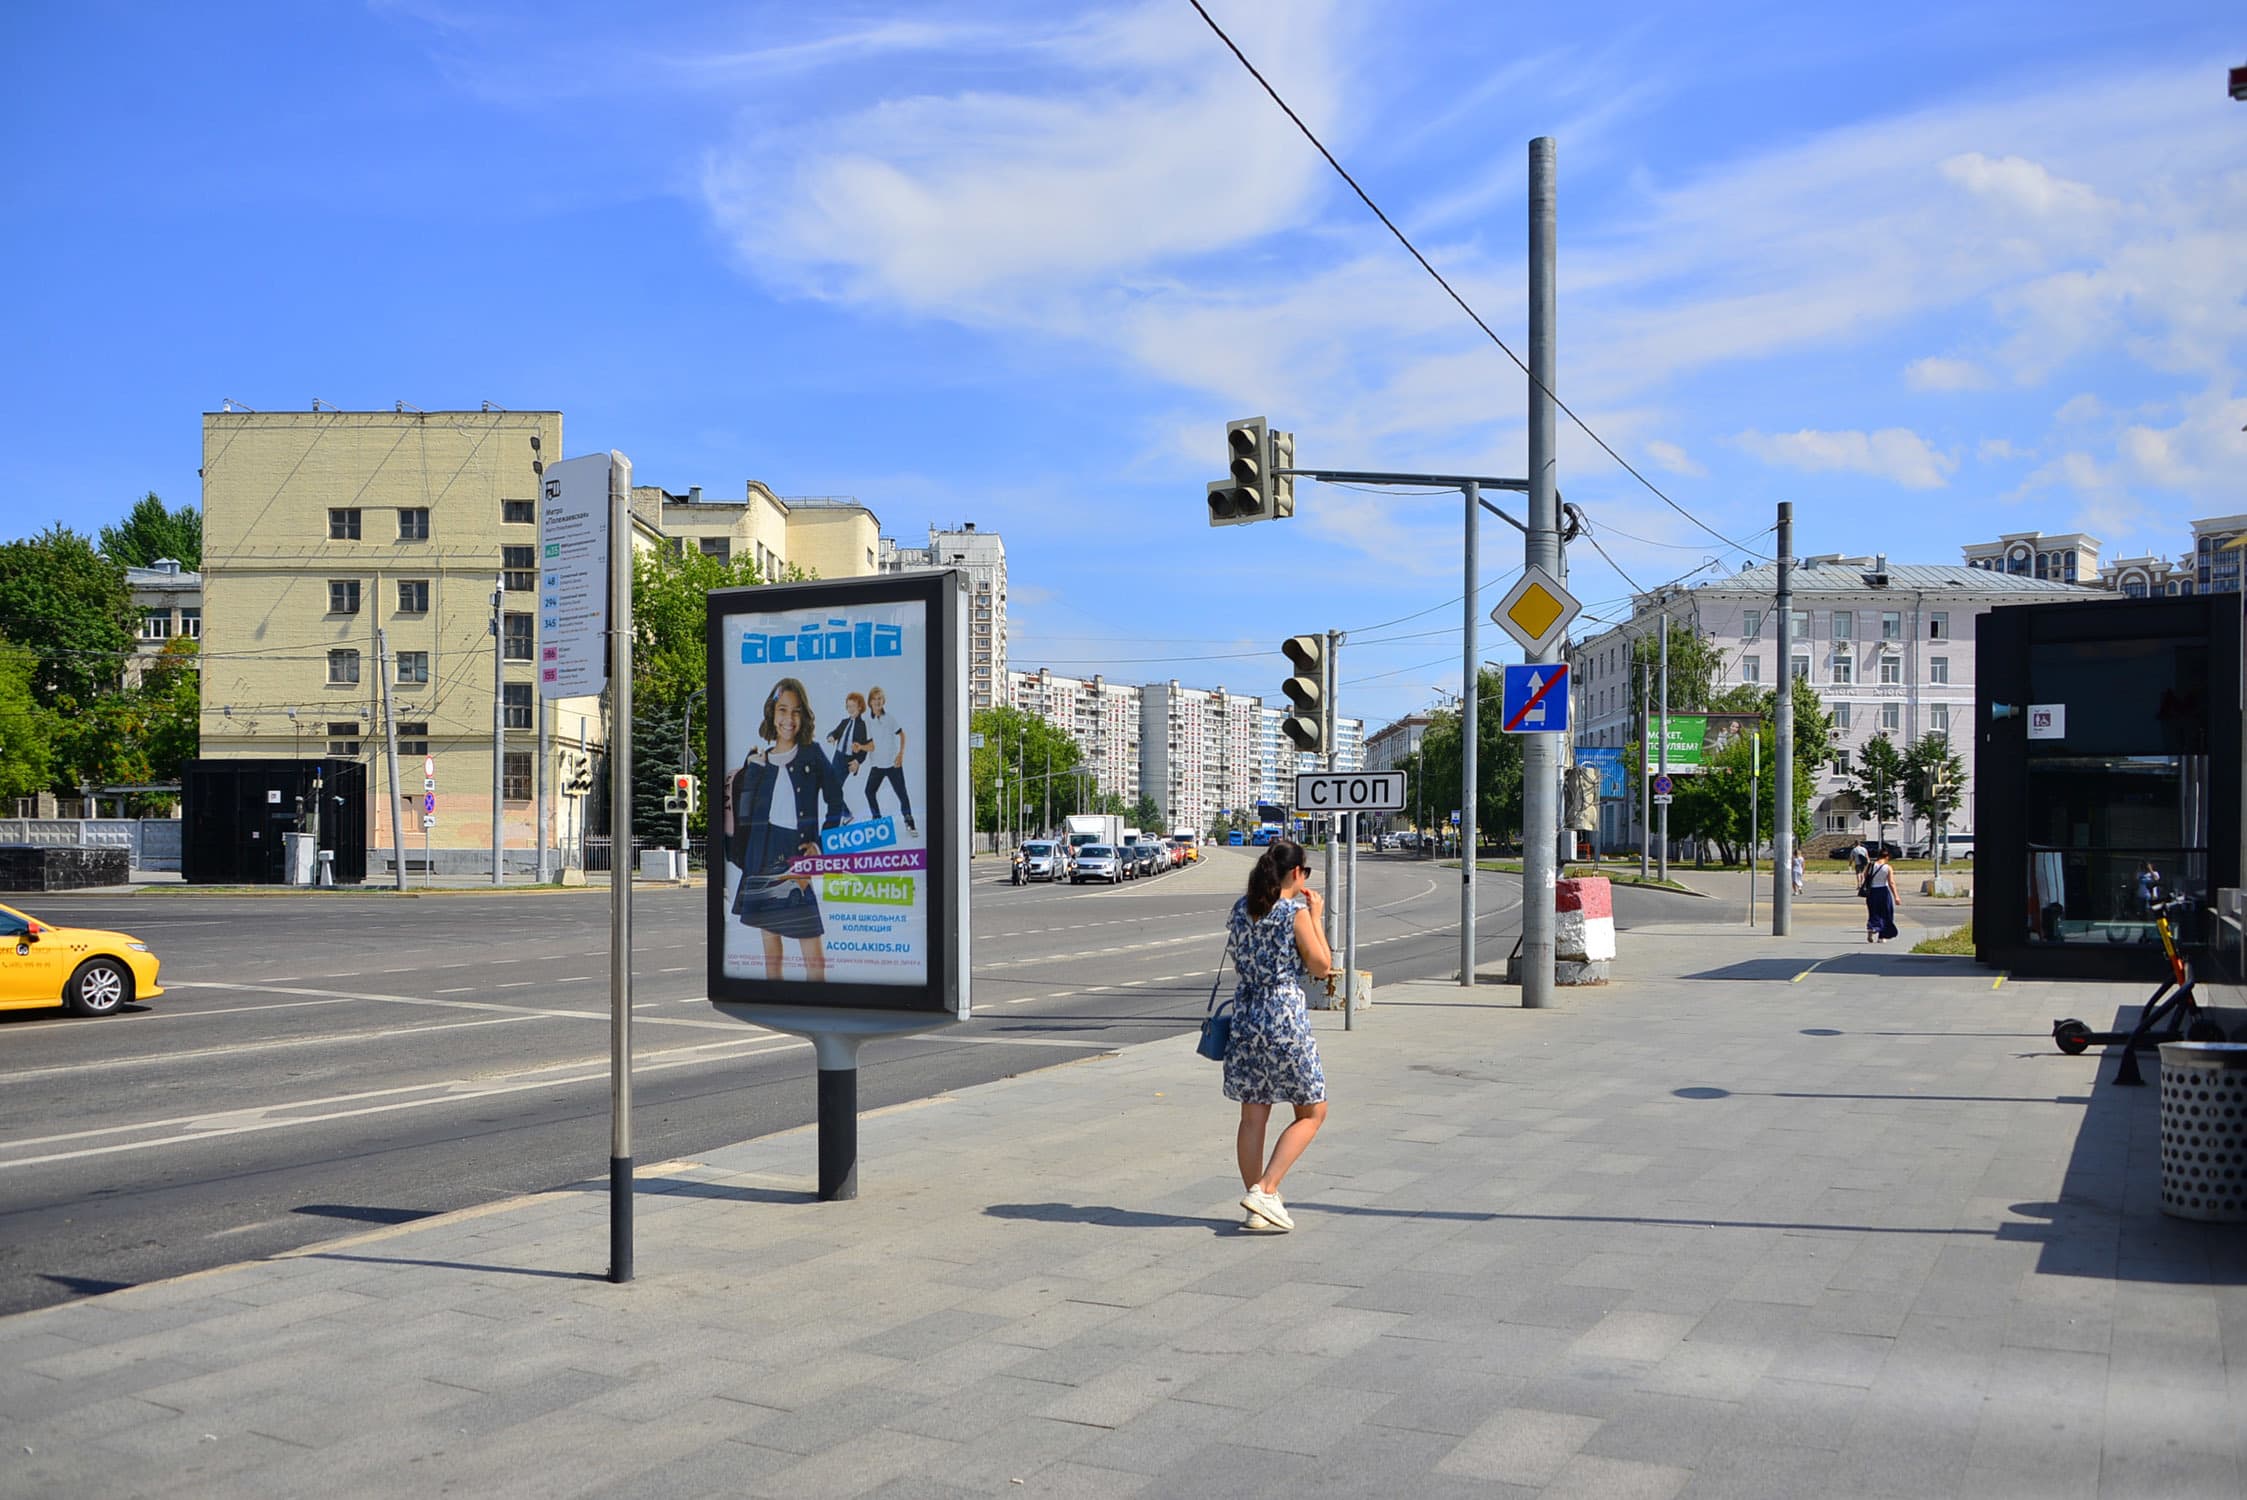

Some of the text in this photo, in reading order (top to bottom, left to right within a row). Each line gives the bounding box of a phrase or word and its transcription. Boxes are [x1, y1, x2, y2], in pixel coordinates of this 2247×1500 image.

[544, 598, 557, 608] 294
[544, 618, 557, 629] 345
[1648, 742, 1699, 751] ПОУЛЯЕМ?
[1311, 779, 1389, 805] СТОП
[826, 824, 890, 851] СКОРО
[794, 854, 920, 873] ВО ВСЕХ КЛАССАХ
[828, 880, 908, 900] СТРАНЫ
[829, 913, 907, 923] НОВАЯ ШКОЛЬНАЯ
[842, 924, 892, 933] КОЛЛЕКЦИЯ
[826, 941, 911, 952] ACOOLAKIDS.RU
